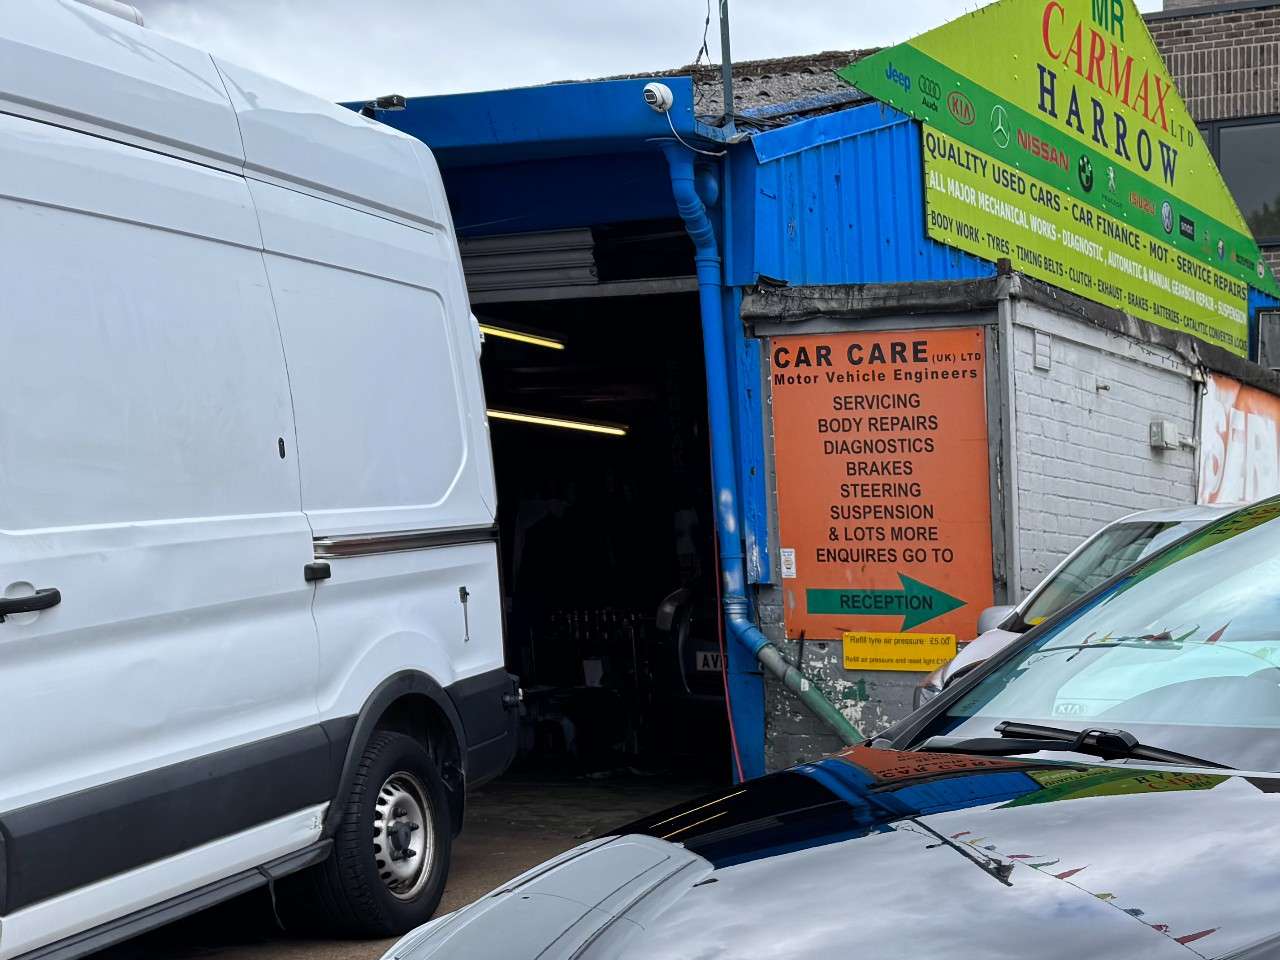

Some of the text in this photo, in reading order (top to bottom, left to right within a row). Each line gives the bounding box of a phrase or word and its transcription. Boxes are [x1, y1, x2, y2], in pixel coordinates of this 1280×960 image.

[1092, 0, 1124, 43] MR
[1042, 1, 1194, 148] CARMAX LTD
[886, 62, 911, 92] Jeep
[922, 98, 938, 112] Audi
[952, 98, 970, 120] KIA
[1017, 128, 1070, 171] NISSAN
[1037, 63, 1178, 187] HARROW
[930, 170, 945, 193] ALL
[947, 176, 976, 206] MAJOR
[978, 191, 1029, 229] MECHANICAL
[1030, 213, 1057, 240] WORKS
[926, 132, 987, 177] QUALITY
[992, 163, 1026, 195] USED
[1030, 183, 1061, 212] CARS
[1072, 203, 1093, 229] CAR
[1097, 214, 1140, 250] FINANCE
[1150, 240, 1168, 263] MOT
[1177, 255, 1212, 287] SERVICE
[1214, 275, 1248, 301] REPAIRS
[931, 210, 953, 232] BODY
[956, 220, 979, 243] WORK
[987, 233, 1009, 255] TYRES
[1016, 245, 1042, 268] TIMING
[1044, 256, 1063, 276] BELTS
[1069, 267, 1092, 288] CLUTCH
[1098, 279, 1122, 300] EXHAUST
[1128, 292, 1148, 312] BRAKES
[773, 340, 982, 368] CAR CARE (UK) LTD
[774, 368, 978, 386] Motor Vehicle Engineers
[833, 393, 921, 411] SERVICING
[818, 415, 938, 433] BODY REPAIRS
[824, 437, 935, 455] DIAGNOSTICS
[846, 460, 913, 476] BRAKES
[840, 482, 921, 498] STEERING
[830, 504, 934, 520] SUSPENSION
[828, 526, 939, 541] & LOTS MORE
[816, 547, 954, 564] ENQUIRES GO TO
[839, 594, 934, 611] RECEPTION
